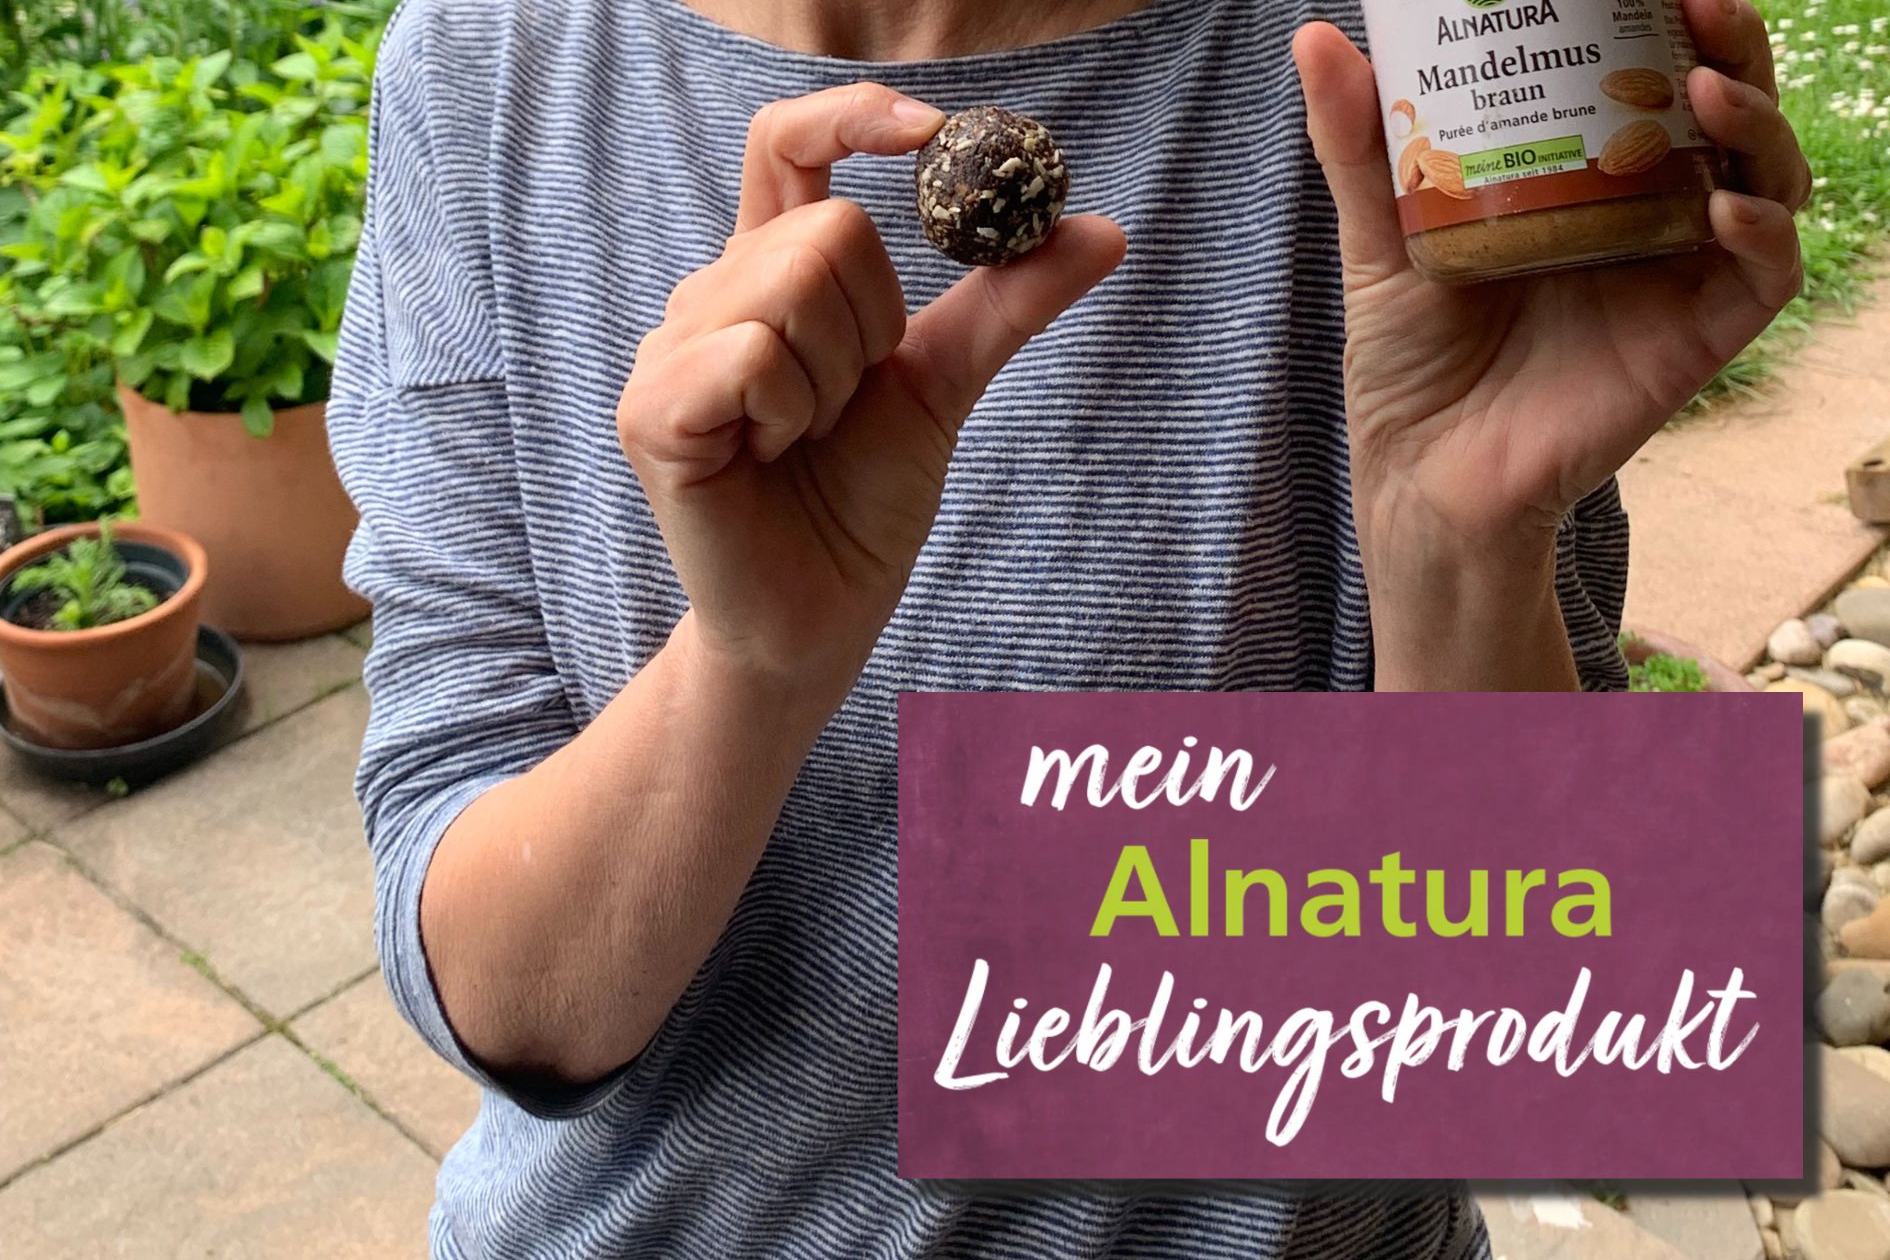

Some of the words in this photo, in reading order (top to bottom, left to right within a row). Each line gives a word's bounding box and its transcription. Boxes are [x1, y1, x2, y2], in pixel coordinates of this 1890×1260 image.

[1417, 43, 1601, 96] Mandelmus
[1471, 84, 1546, 111] braun
[1439, 124, 1474, 141] Purée
[1477, 111, 1548, 133] d'amande
[1553, 105, 1597, 120] brune
[1465, 159, 1502, 177] meine
[1504, 149, 1536, 169] BIO
[1538, 149, 1583, 163] INITIATIVE
[1484, 172, 1520, 184] Alnatura
[1522, 169, 1539, 179] seit
[1542, 164, 1565, 175] 1984
